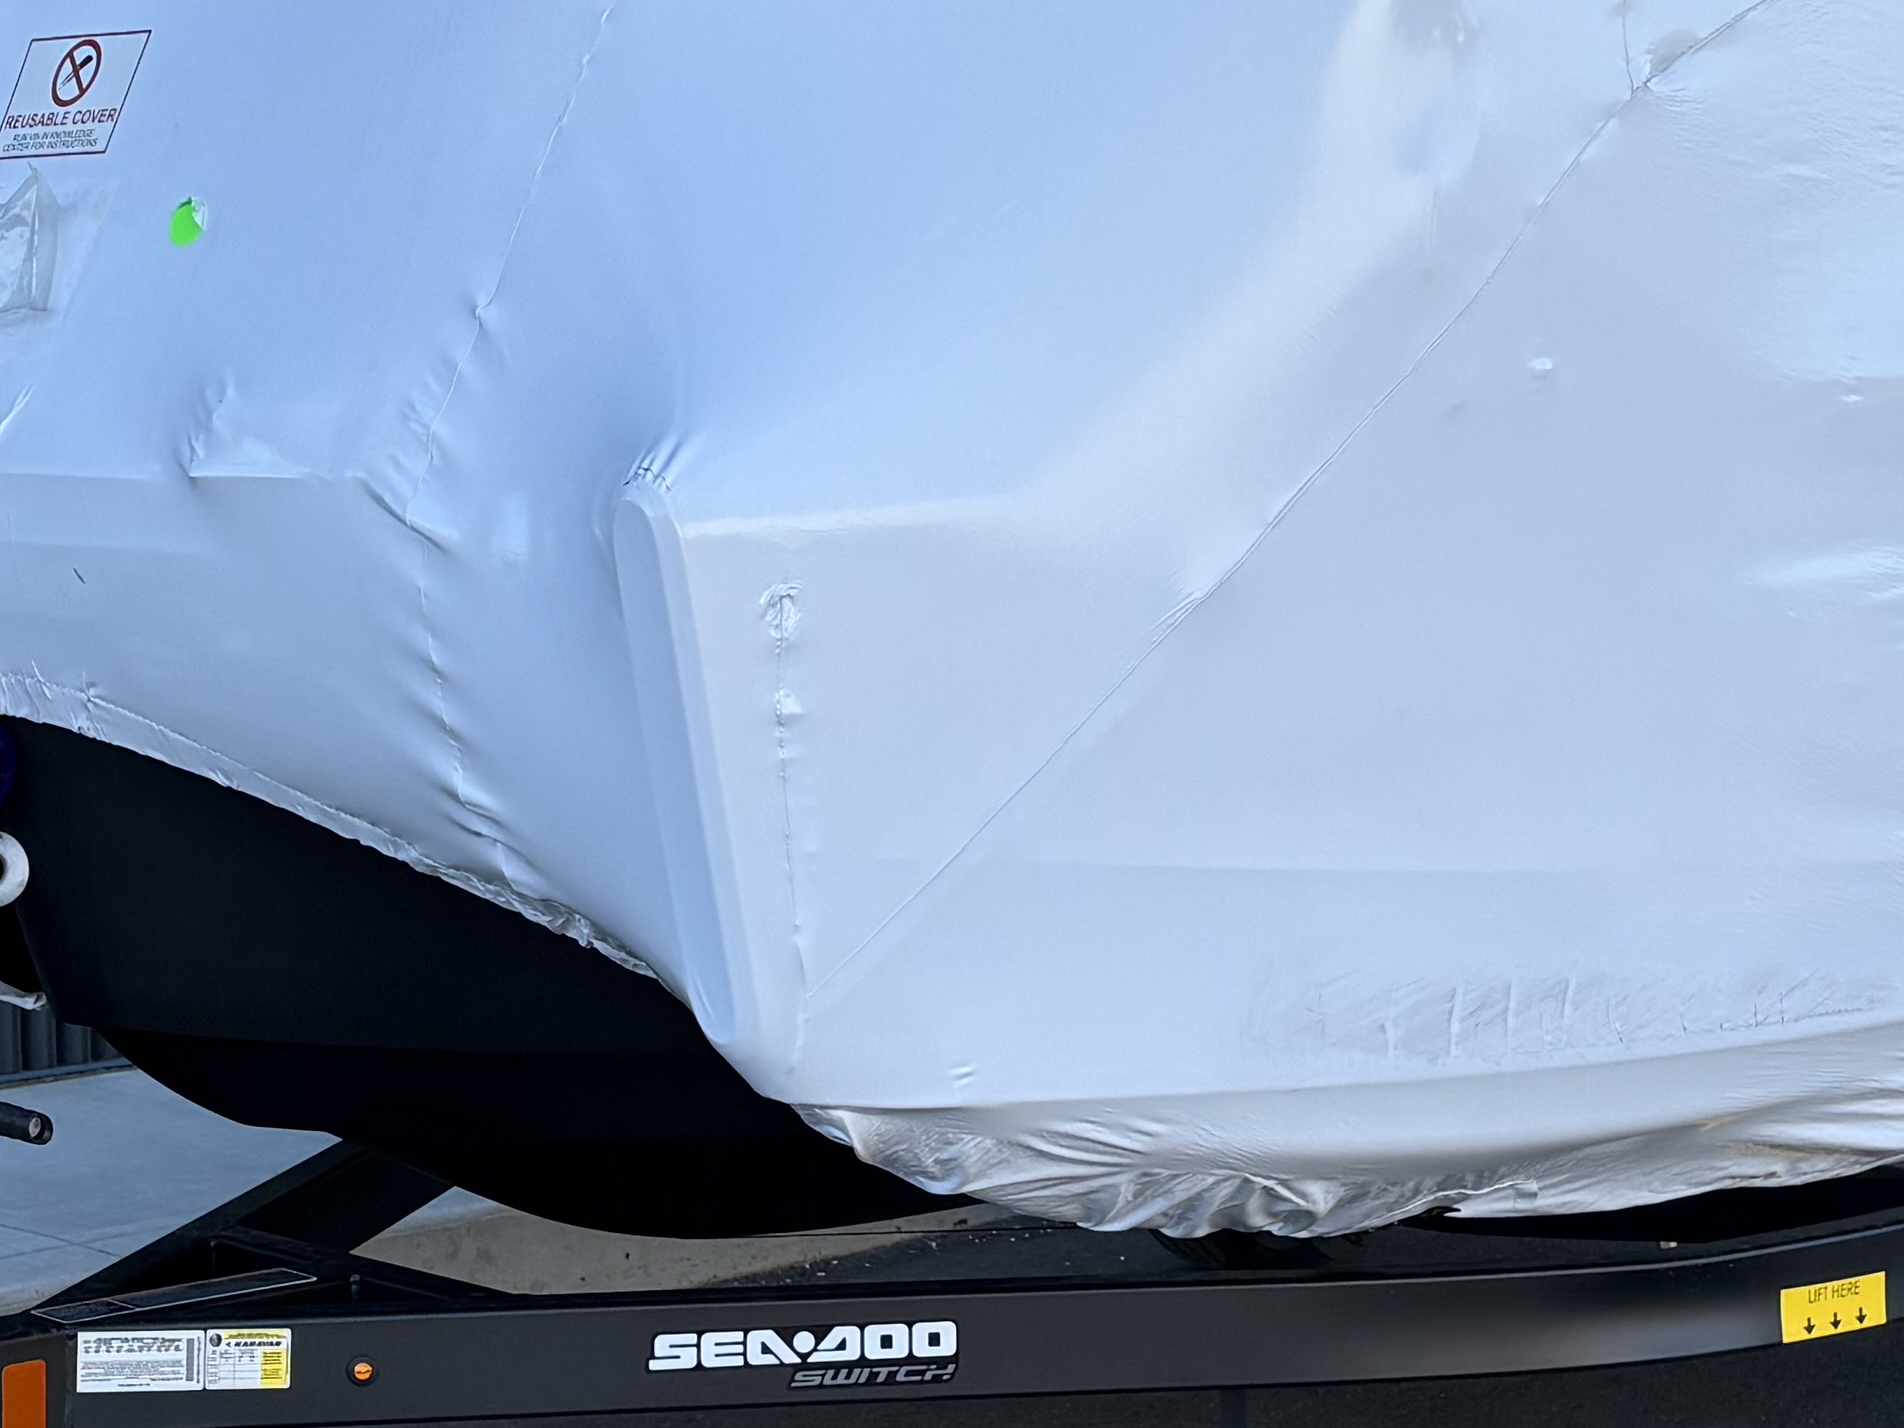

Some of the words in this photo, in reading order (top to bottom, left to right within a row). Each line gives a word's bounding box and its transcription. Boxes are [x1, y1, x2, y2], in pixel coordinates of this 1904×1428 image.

[4, 111, 71, 129] REUSABLE
[72, 108, 117, 125] COVER
[1808, 1286, 1827, 1303] LIFT
[1831, 1280, 1860, 1298] HERE
[791, 1363, 956, 1387] SWITCH
